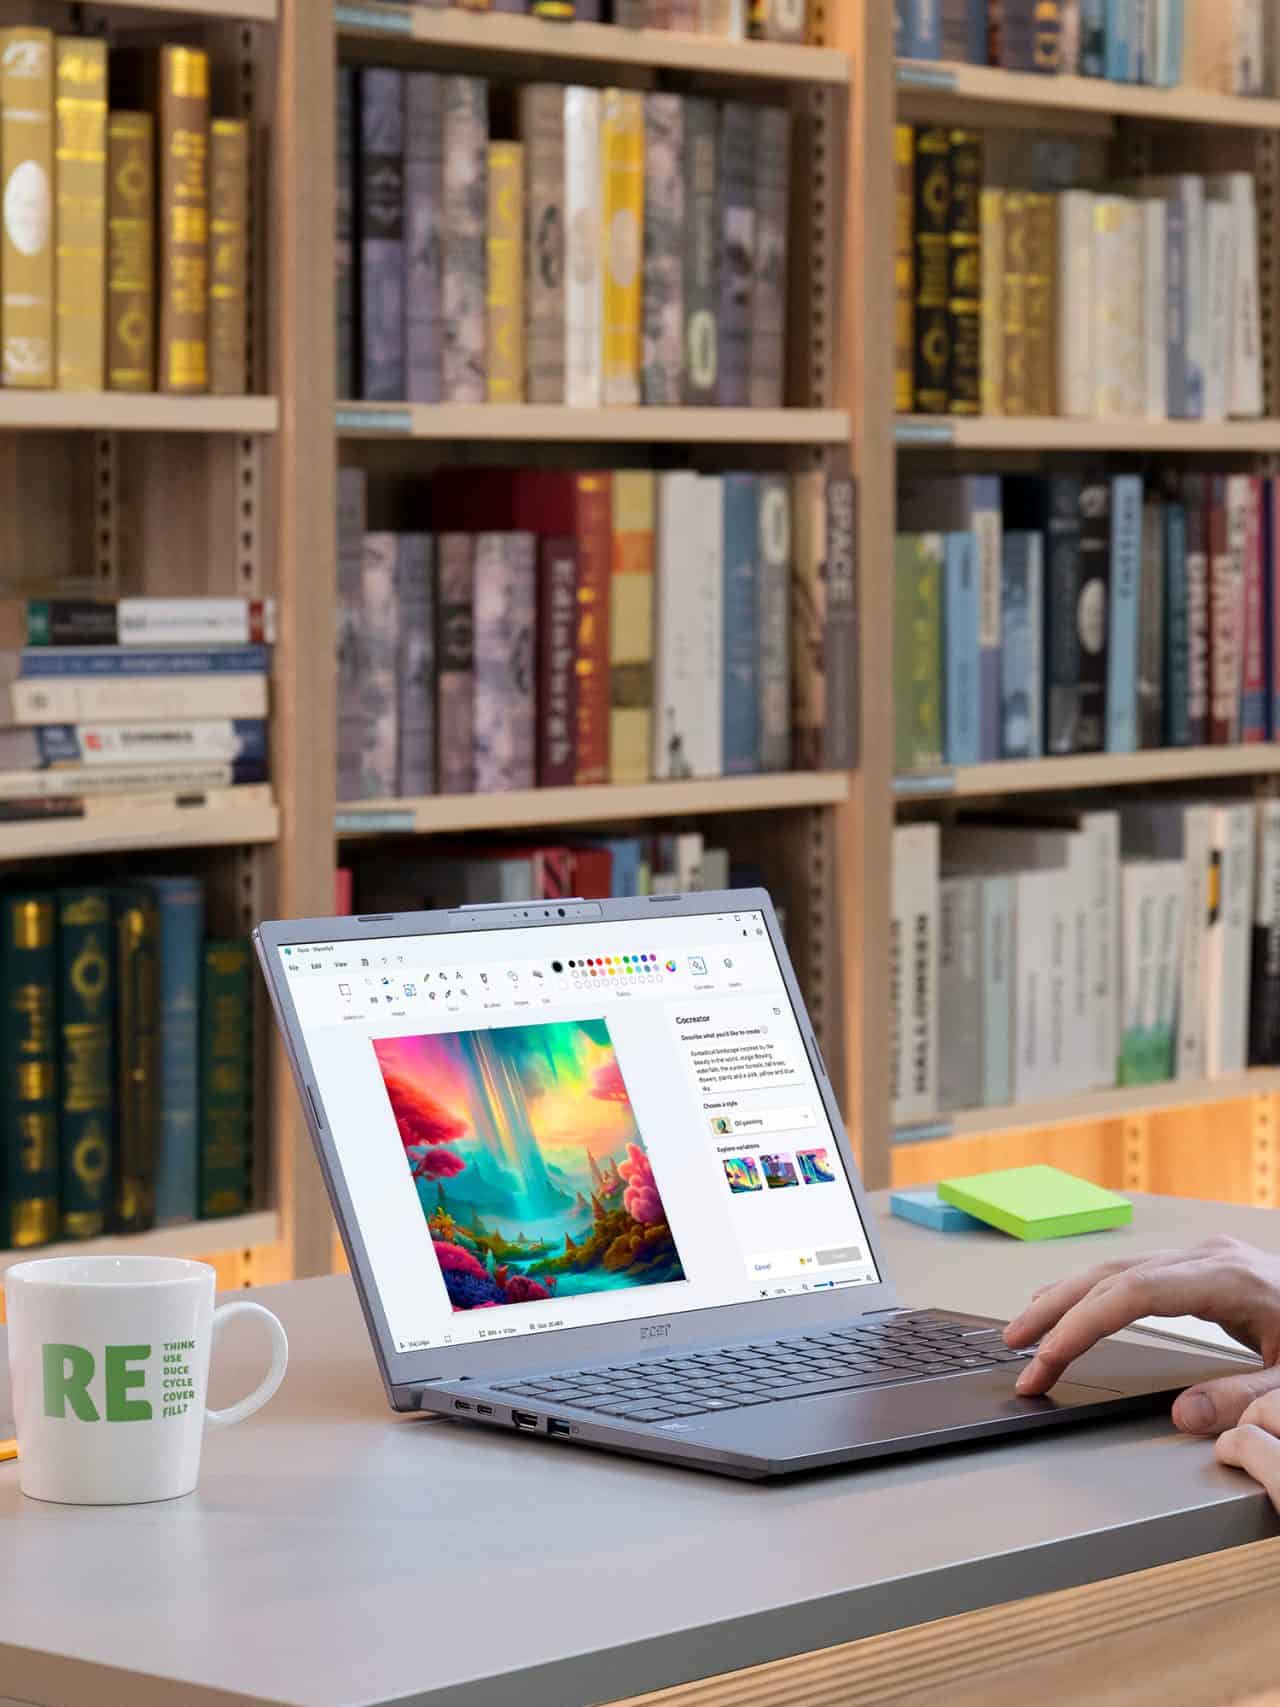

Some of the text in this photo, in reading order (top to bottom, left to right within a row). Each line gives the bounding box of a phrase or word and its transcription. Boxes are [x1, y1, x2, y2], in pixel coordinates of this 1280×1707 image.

[829, 481, 854, 600] SPACE
[549, 558, 574, 764] Edinburgh
[675, 1015, 710, 1025] Cocreator
[163, 1340, 195, 1351] THINK
[163, 1354, 182, 1363] USE
[163, 1366, 189, 1376] DUCE
[42, 1343, 153, 1422] RE
[163, 1378, 193, 1388] CYCLE
[163, 1390, 195, 1402] COVER
[163, 1403, 188, 1418] FILL?
